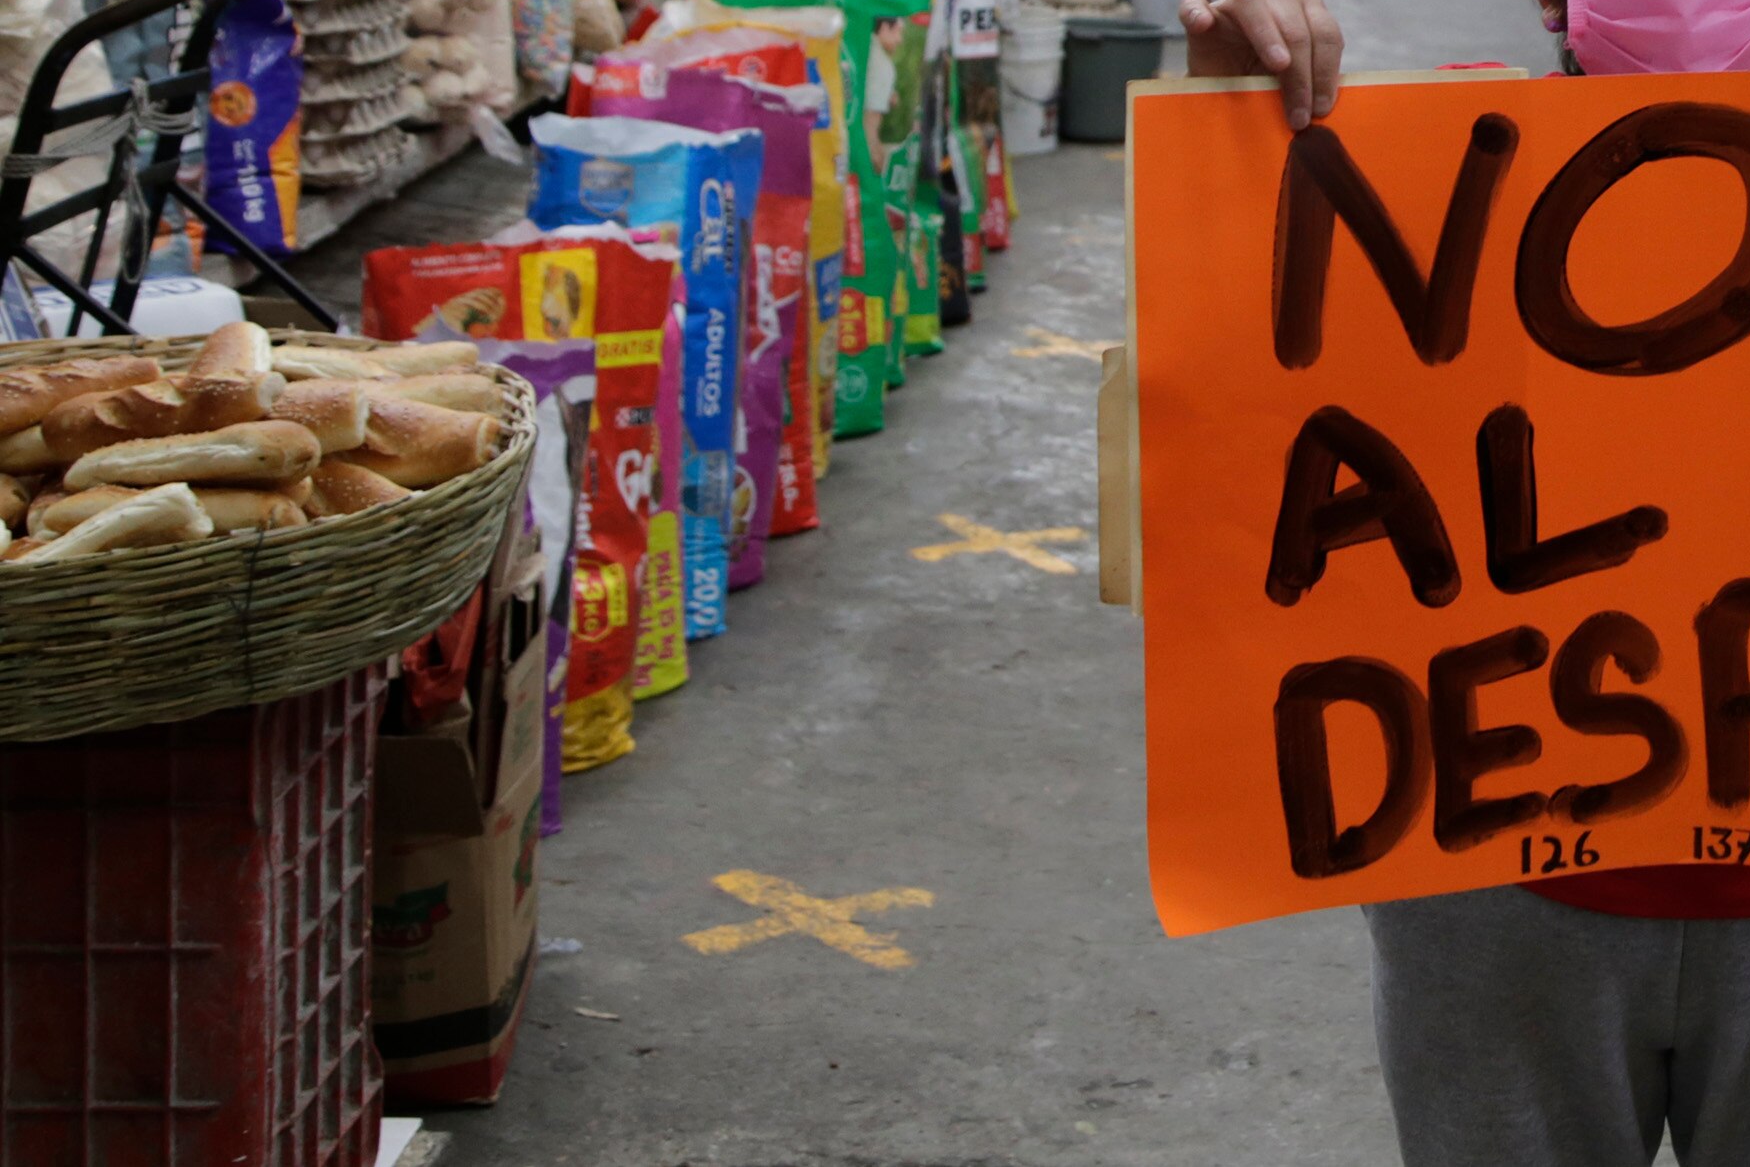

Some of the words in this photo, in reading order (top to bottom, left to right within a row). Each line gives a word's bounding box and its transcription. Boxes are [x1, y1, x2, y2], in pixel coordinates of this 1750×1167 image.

[703, 308, 725, 417] ADULTOS
[1266, 402, 1668, 608] AL
[1521, 830, 1600, 875] 126
